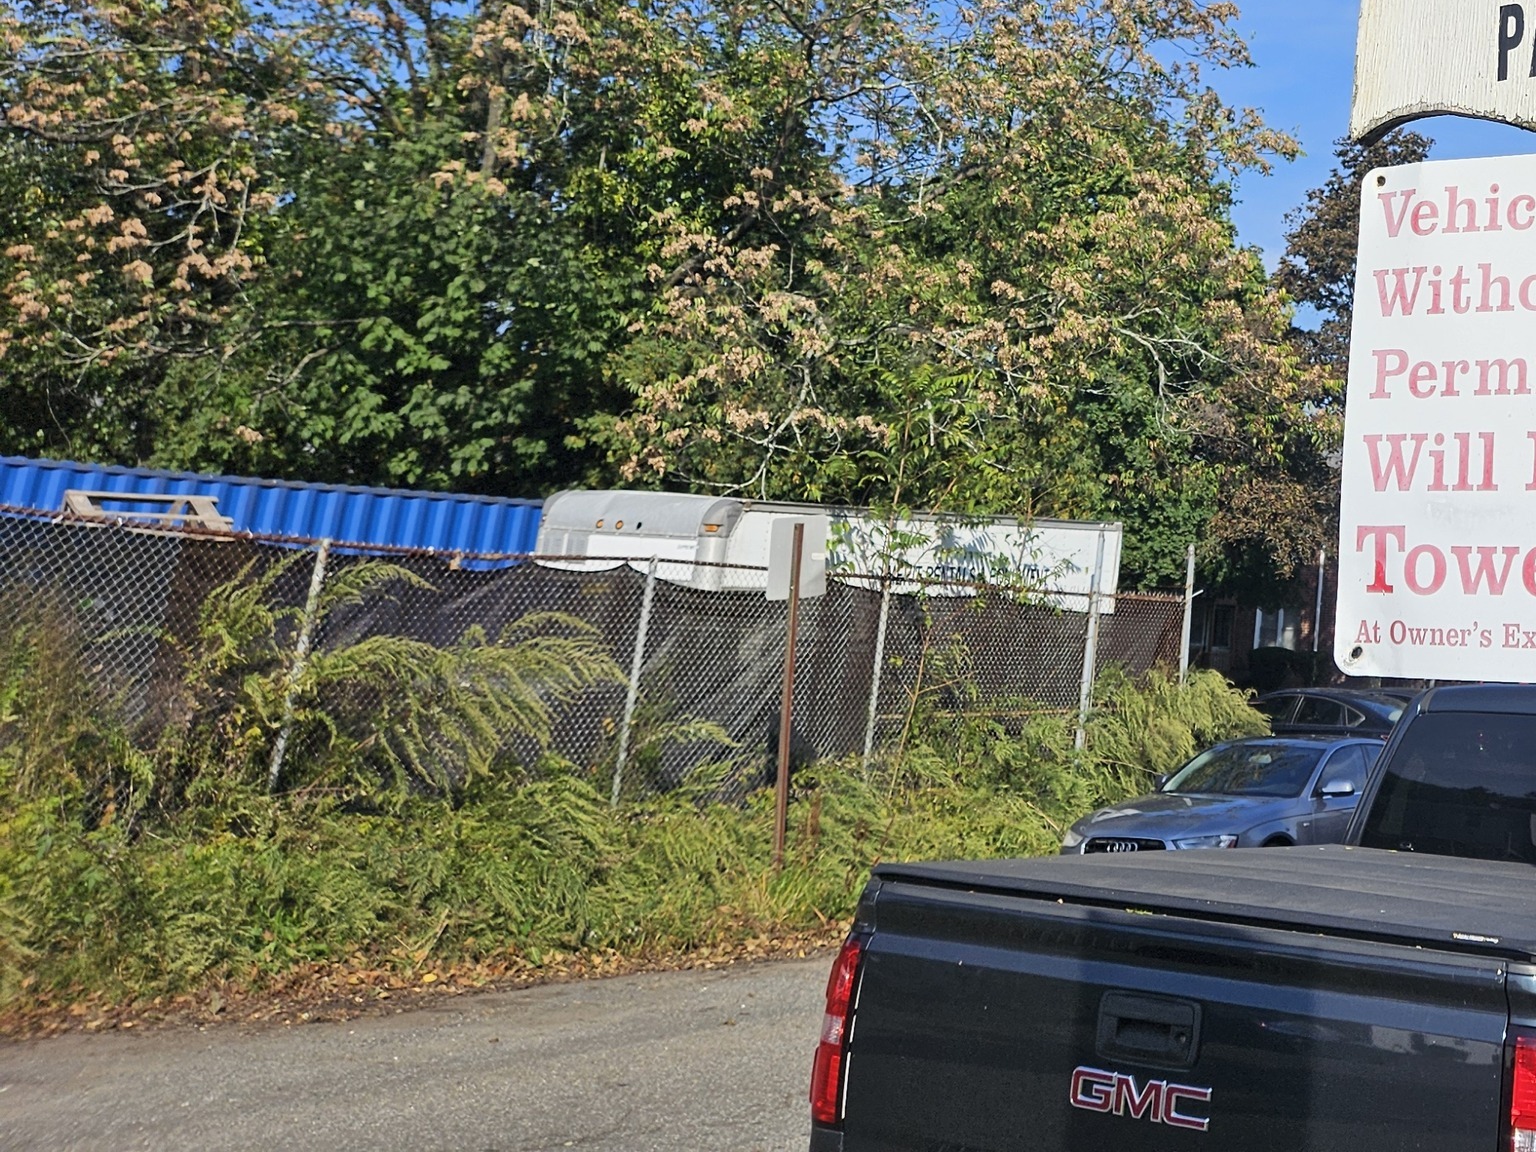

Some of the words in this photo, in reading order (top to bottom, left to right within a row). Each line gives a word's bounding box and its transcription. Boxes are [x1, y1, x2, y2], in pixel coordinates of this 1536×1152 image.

[1362, 431, 1499, 493] Will
[1354, 619, 1382, 645] At
[1390, 619, 1492, 650] Owner's
[1070, 1065, 1213, 1133] GMC
